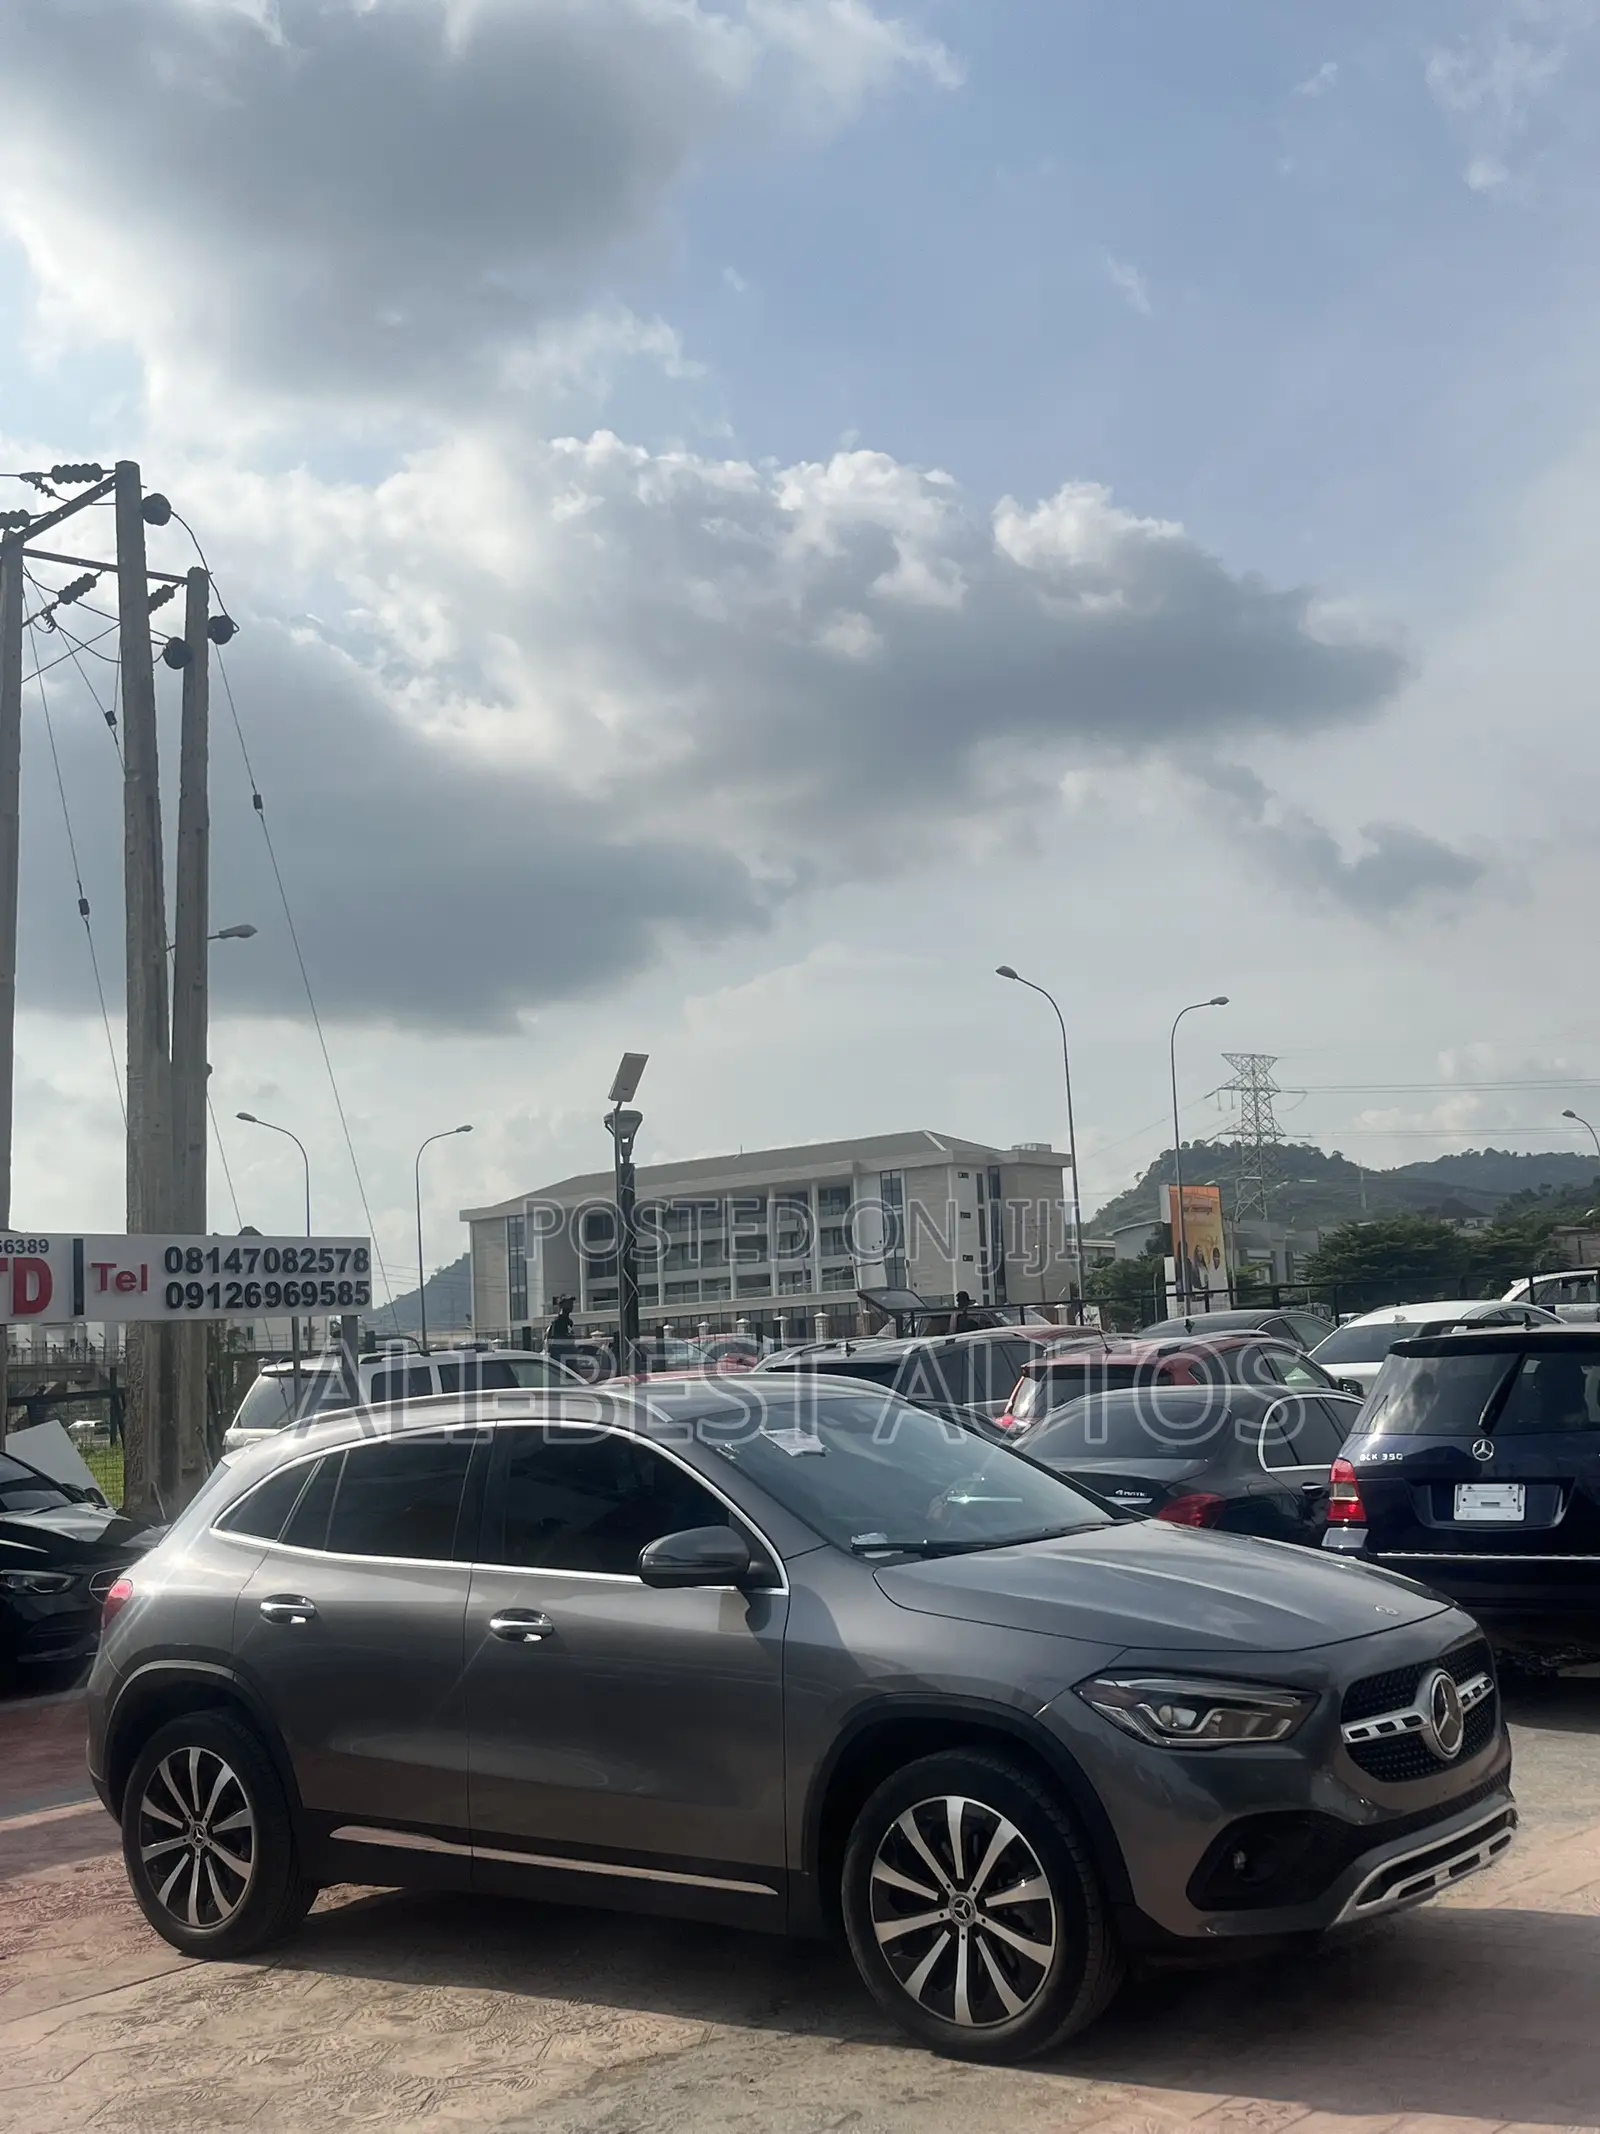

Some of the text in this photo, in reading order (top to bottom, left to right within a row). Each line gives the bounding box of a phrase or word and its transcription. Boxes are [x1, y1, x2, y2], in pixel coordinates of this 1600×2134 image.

[0, 1239, 49, 1254] 6389
[164, 1246, 369, 1274] 08147082578
[91, 1263, 148, 1292] Tel
[165, 1280, 370, 1309] 09126969585
